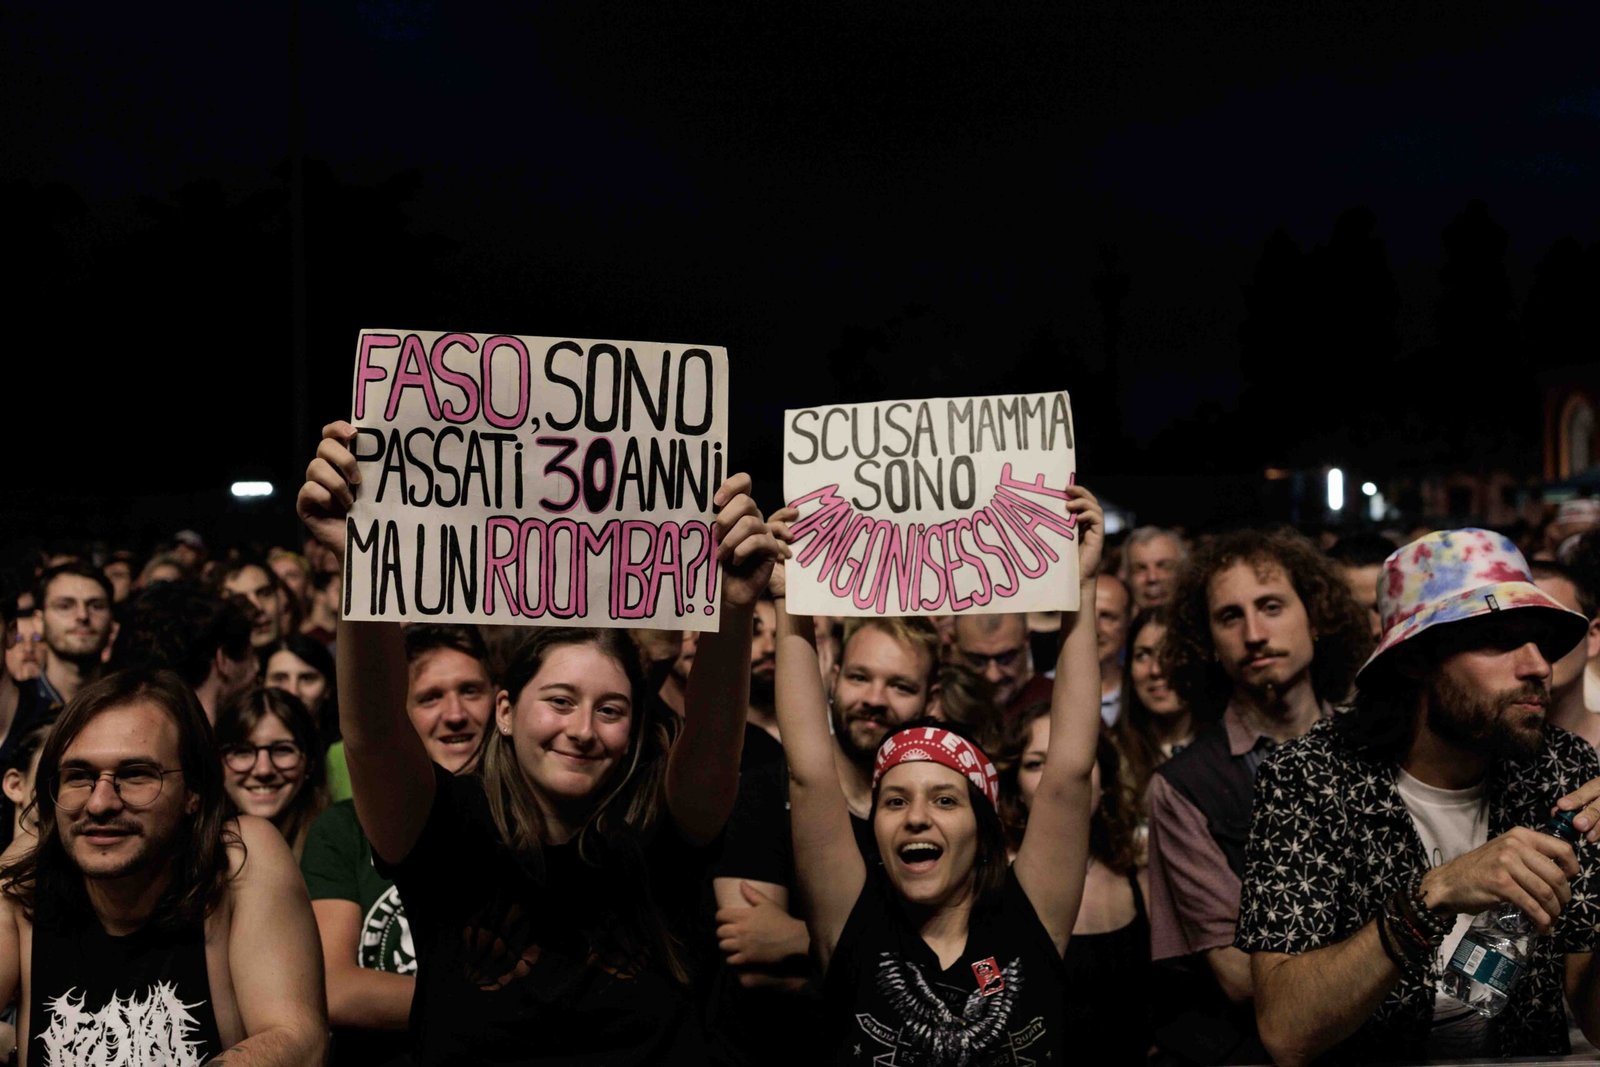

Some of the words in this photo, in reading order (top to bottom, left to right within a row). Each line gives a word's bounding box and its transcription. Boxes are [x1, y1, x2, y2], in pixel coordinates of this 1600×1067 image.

[354, 332, 540, 434] FASO,
[544, 341, 714, 433] SONO
[787, 401, 938, 464] SCUSA
[947, 393, 1073, 455] MAMMA
[535, 435, 618, 514] 30
[852, 455, 977, 513] SONO
[344, 517, 407, 616] MA
[414, 524, 478, 615] UN
[484, 516, 720, 620] ROOMBA?!
